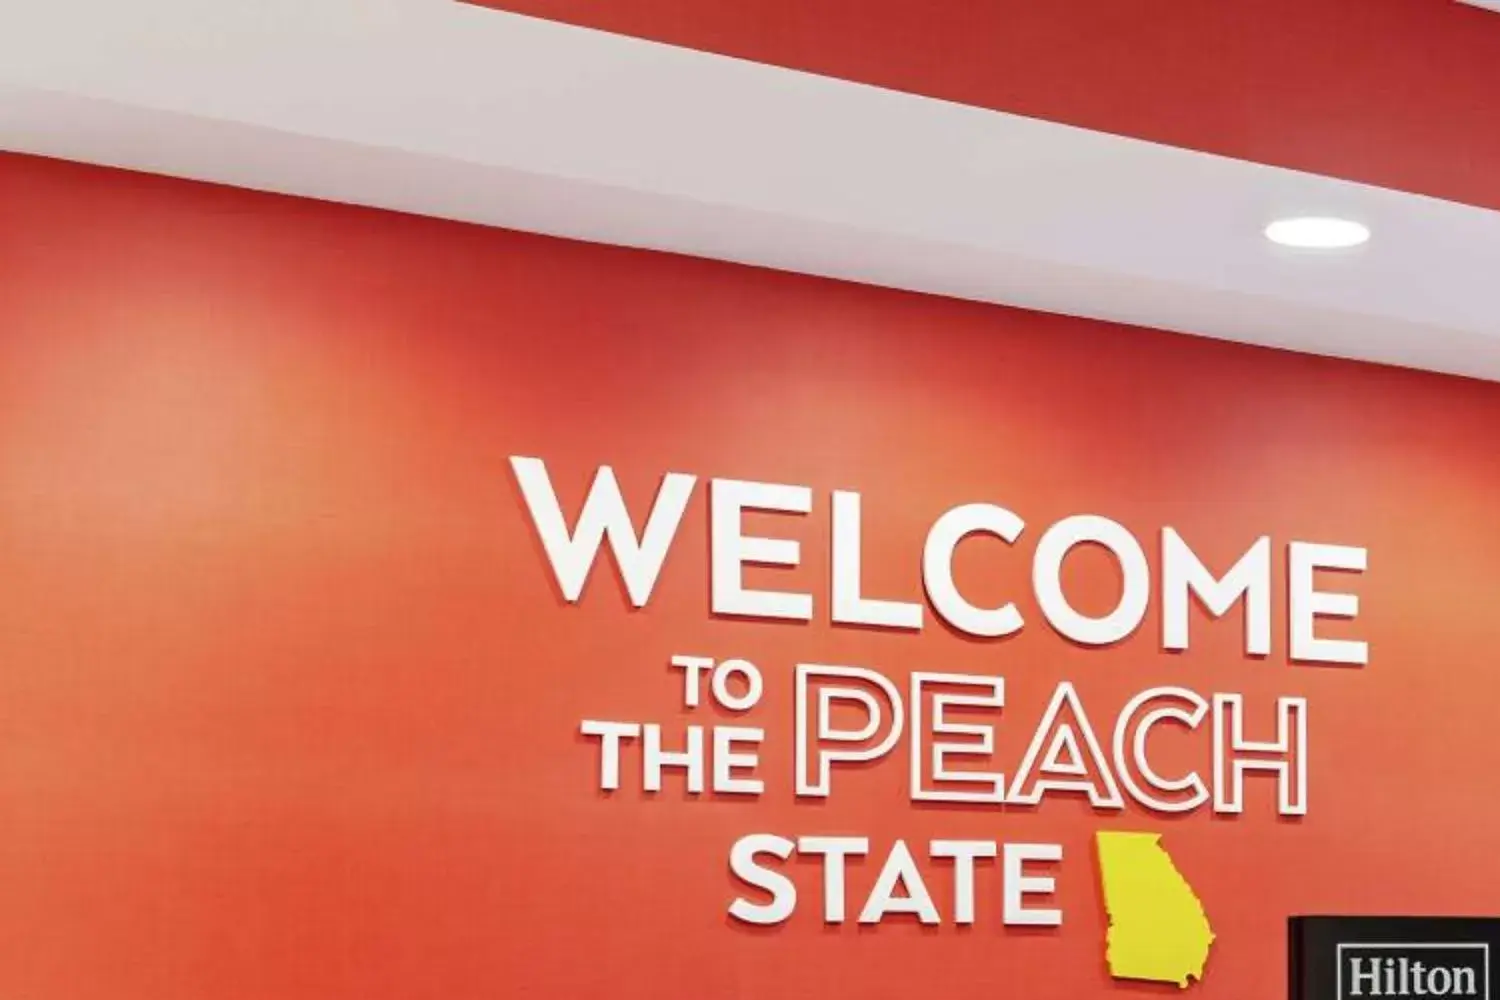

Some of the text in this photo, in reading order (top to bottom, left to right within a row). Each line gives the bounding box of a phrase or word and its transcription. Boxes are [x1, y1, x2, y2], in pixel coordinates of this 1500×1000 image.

[509, 455, 1369, 665] WELCOME
[671, 654, 763, 712] TO
[581, 663, 1307, 816] THE PEACH
[728, 833, 1063, 927] STATE
[1349, 956, 1477, 996] Hilton
